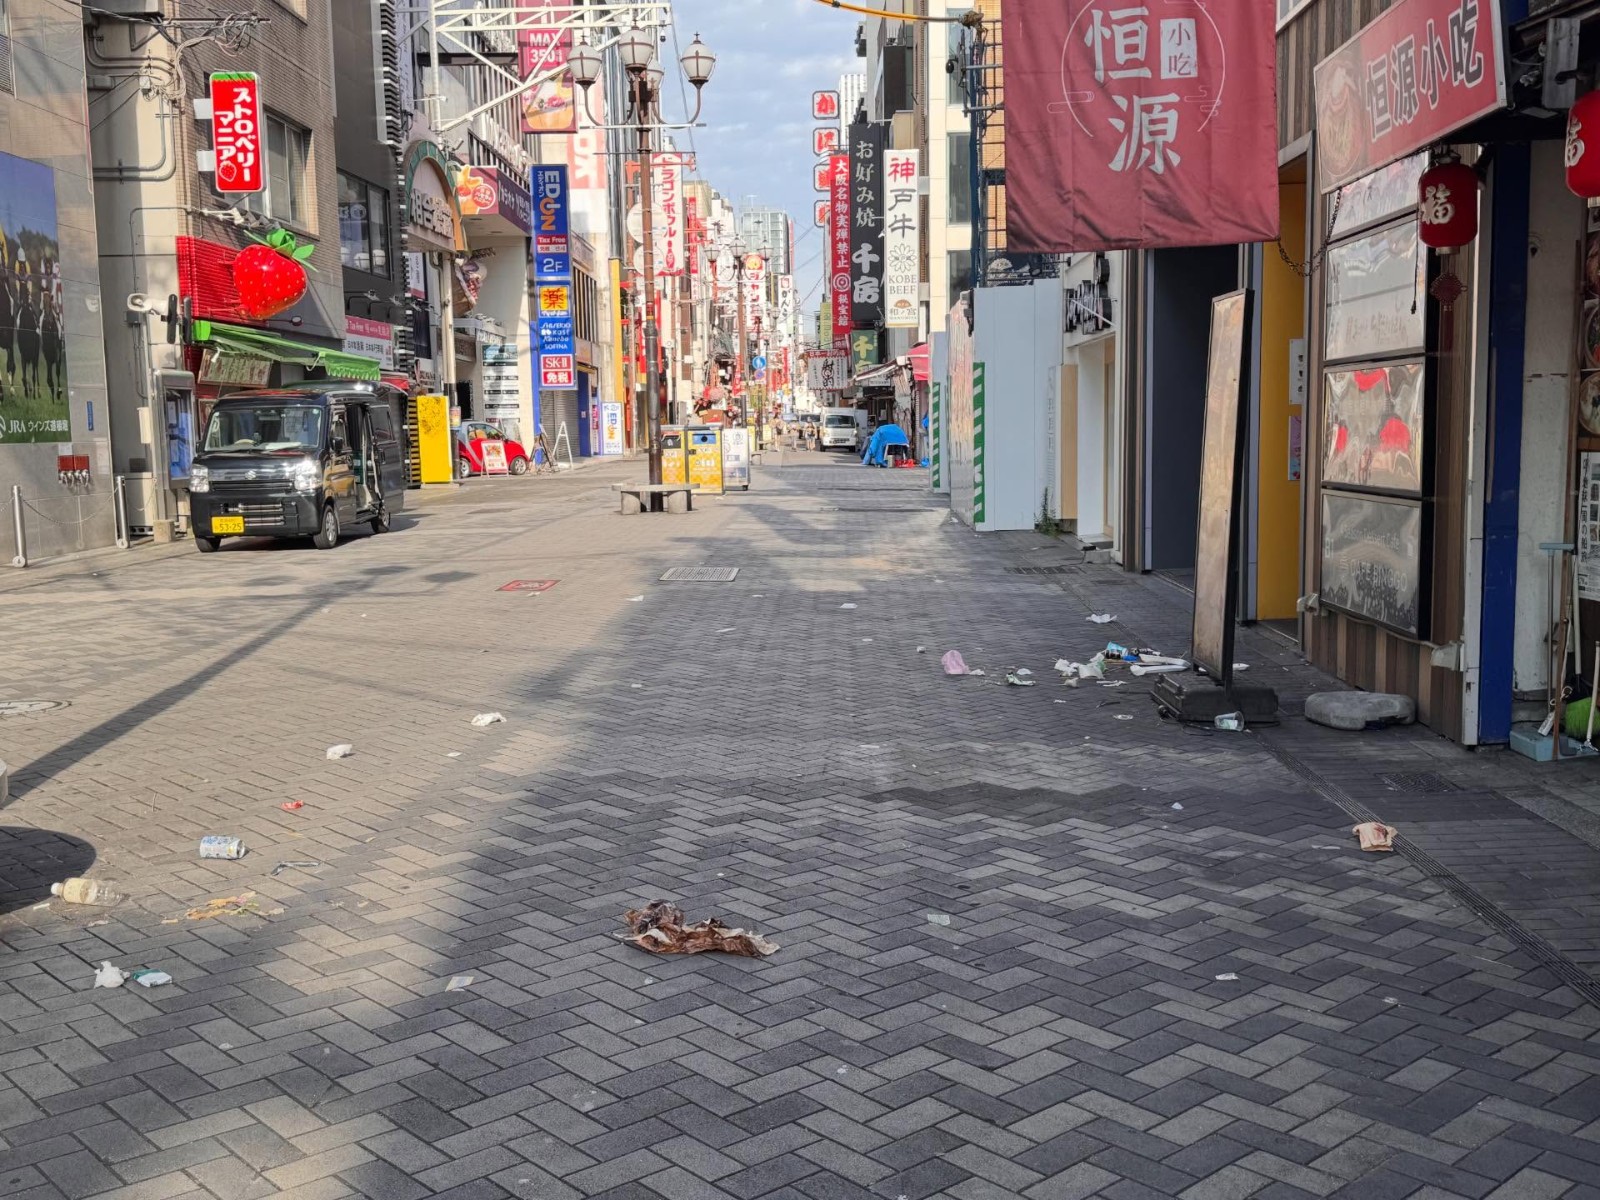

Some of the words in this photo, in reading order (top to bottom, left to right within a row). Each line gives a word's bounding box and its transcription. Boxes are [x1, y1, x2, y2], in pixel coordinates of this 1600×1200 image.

[529, 33, 561, 47] MAX
[1168, 24, 1192, 77] 小吃
[1084, 6, 1181, 175] 恒源
[1365, 4, 1485, 141] 恒源小吃
[215, 111, 236, 160] マニア
[233, 87, 256, 182] ストロベリー
[540, 171, 562, 231] EDION
[856, 141, 875, 228] お好み焼
[887, 157, 917, 239] 神戸牛
[537, 236, 551, 244] Tax
[543, 257, 564, 273] 2F
[852, 242, 880, 303] 千房
[888, 274, 917, 284] KOBE
[888, 285, 916, 294] BEEF
[544, 287, 565, 309] 薬
[546, 371, 569, 384] 免税
[8, 419, 26, 434] JRA
